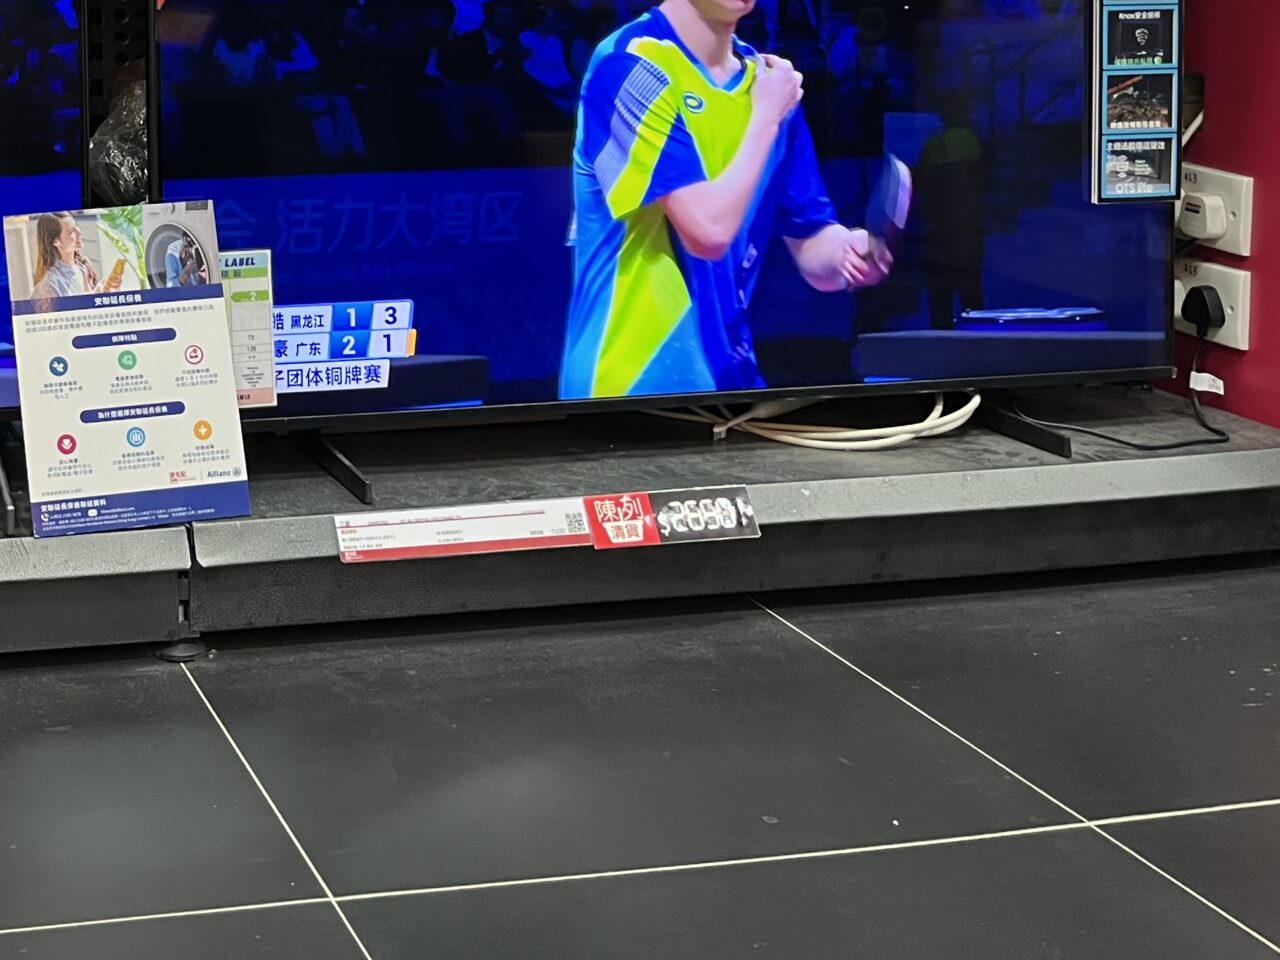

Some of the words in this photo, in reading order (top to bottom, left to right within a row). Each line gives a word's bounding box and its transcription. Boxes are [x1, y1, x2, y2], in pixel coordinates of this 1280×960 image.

[275, 190, 523, 255] 活力大湾区
[224, 256, 256, 267] LABEL
[249, 291, 257, 301] 2
[290, 313, 325, 329] 黑龙江
[346, 307, 357, 327] 1
[384, 306, 398, 325] 3
[295, 340, 321, 357] 广东
[341, 336, 357, 355] 2
[382, 334, 392, 353] 1
[207, 469, 231, 479] Allianz
[593, 494, 644, 523] 陳列
